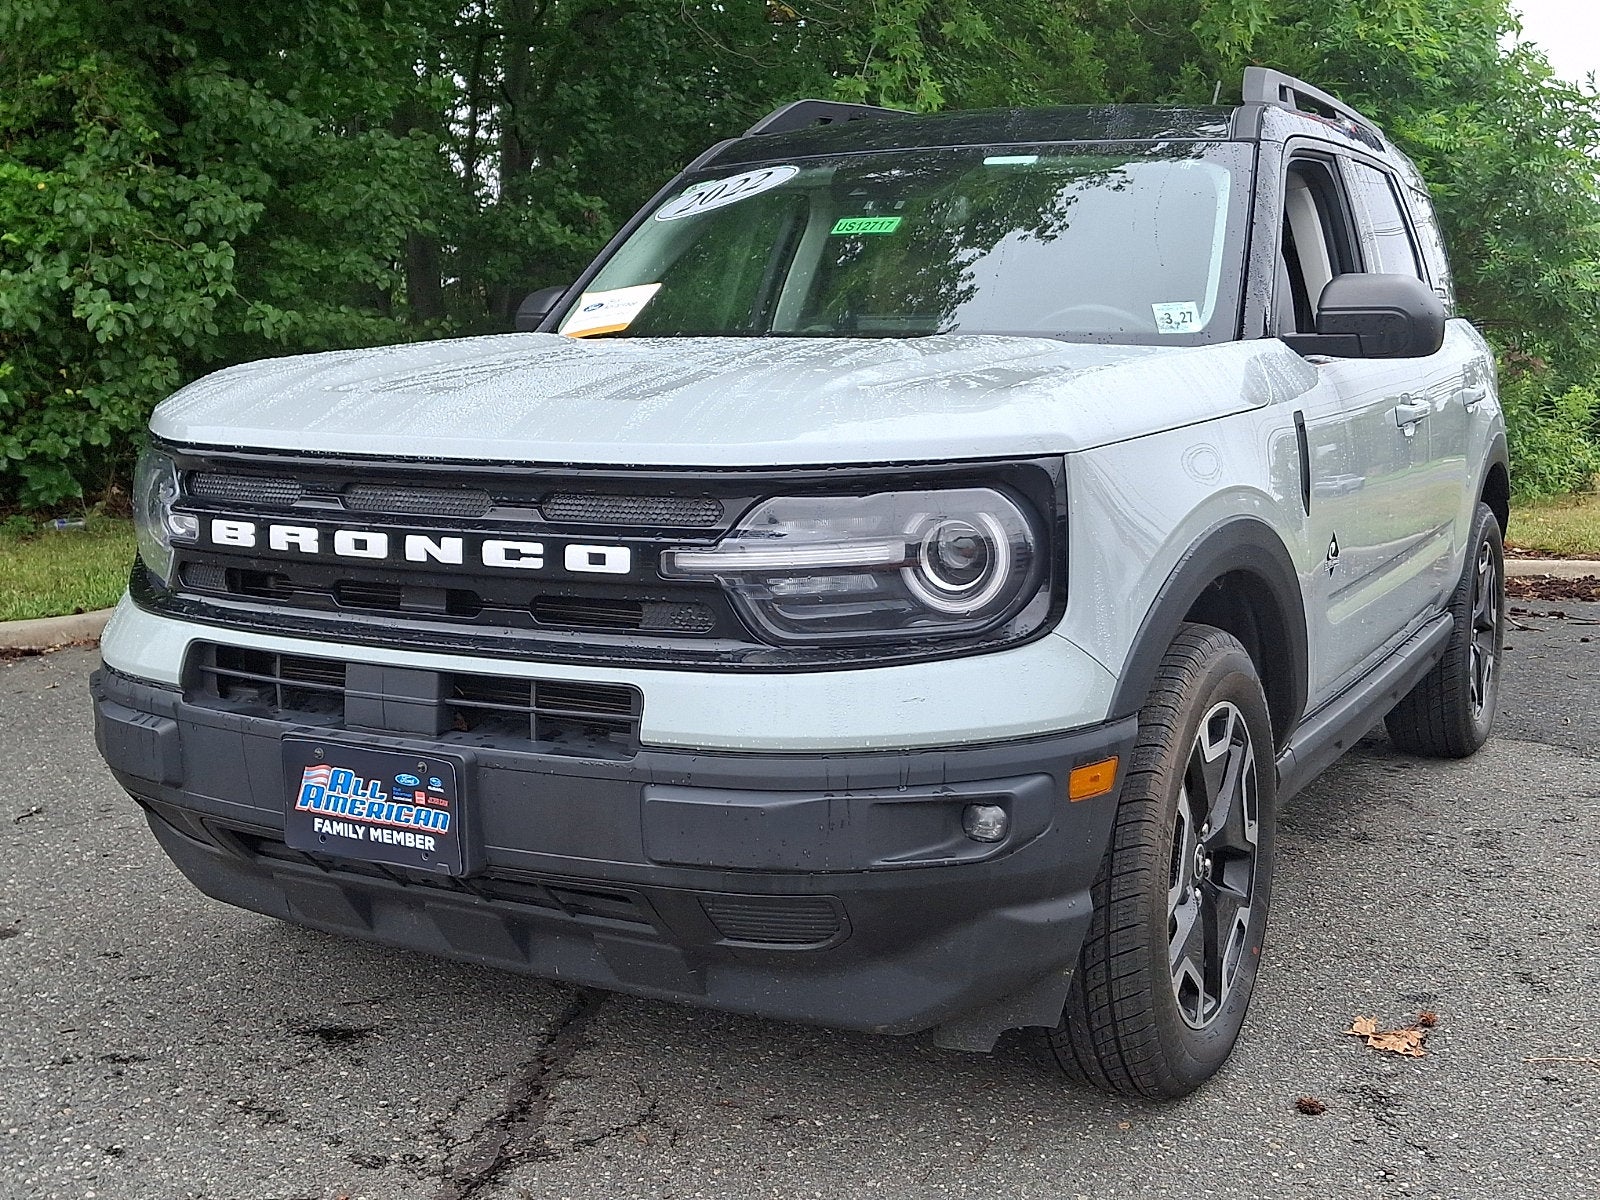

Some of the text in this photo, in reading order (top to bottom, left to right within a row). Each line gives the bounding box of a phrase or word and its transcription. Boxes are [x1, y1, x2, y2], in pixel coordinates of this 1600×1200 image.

[672, 171, 774, 216] 2022
[836, 221, 894, 231] US12717
[1164, 311, 1193, 324] 3 27
[211, 519, 631, 574] BRONCO
[297, 783, 450, 833] AMERICAN
[313, 818, 436, 851] FAMILY MEMBER
